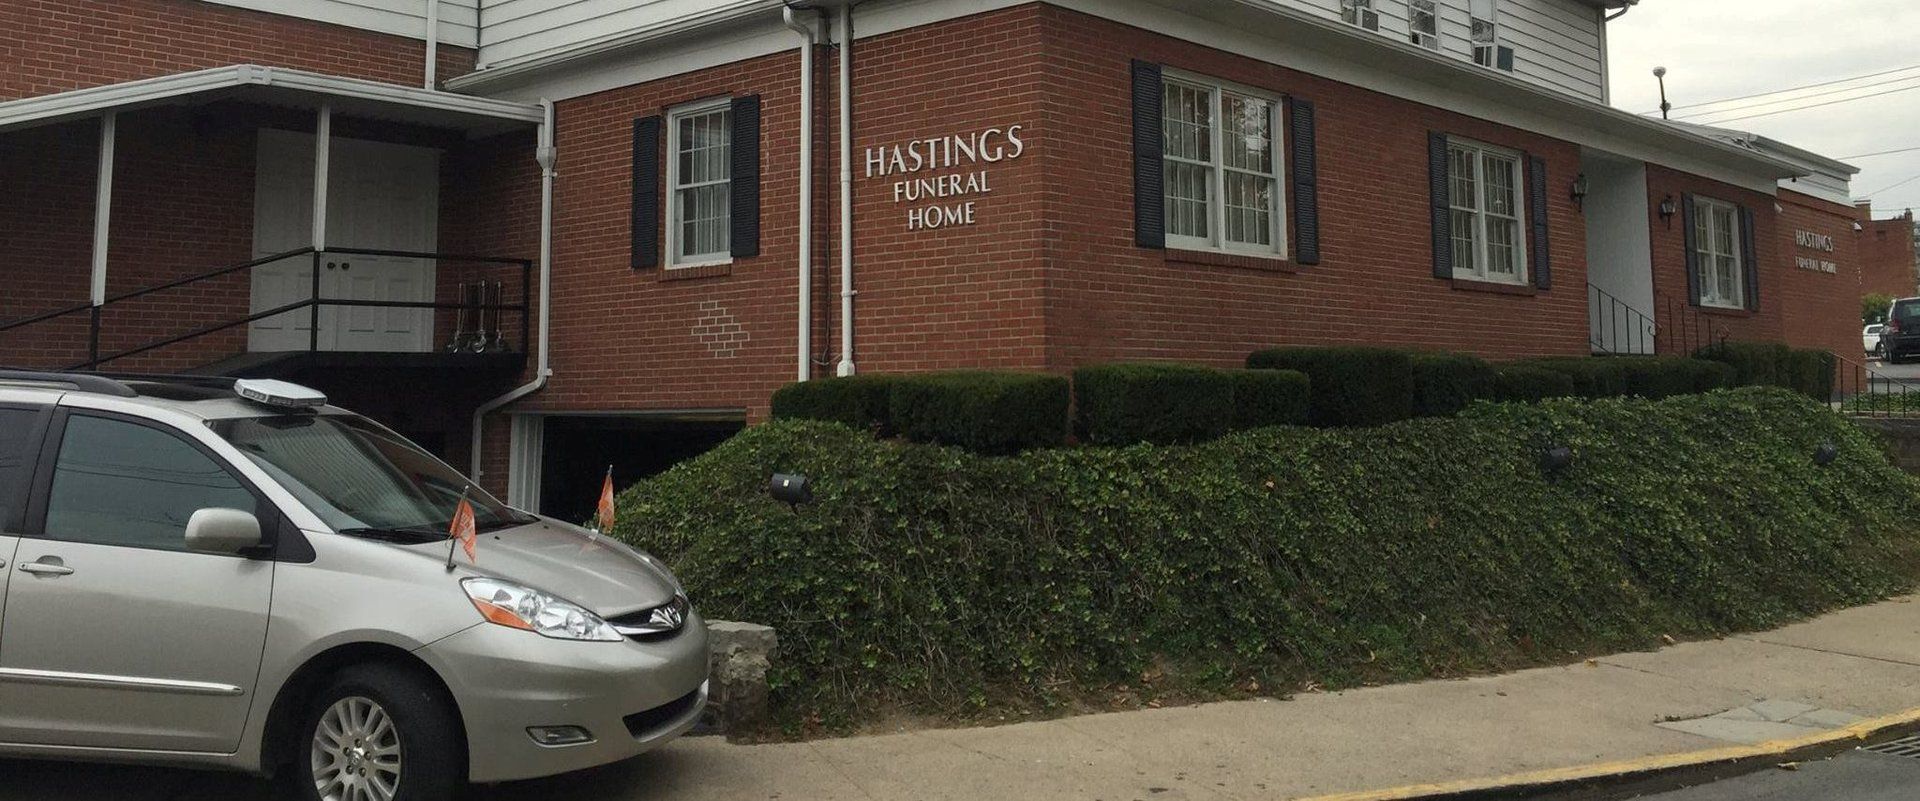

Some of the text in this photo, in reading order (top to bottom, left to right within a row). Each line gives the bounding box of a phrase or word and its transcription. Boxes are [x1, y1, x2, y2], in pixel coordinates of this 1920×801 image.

[866, 125, 1023, 177] HASTINGS
[894, 171, 991, 202] FUNERAL
[908, 202, 976, 230] HOME
[1795, 229, 1833, 252] HASTINGS
